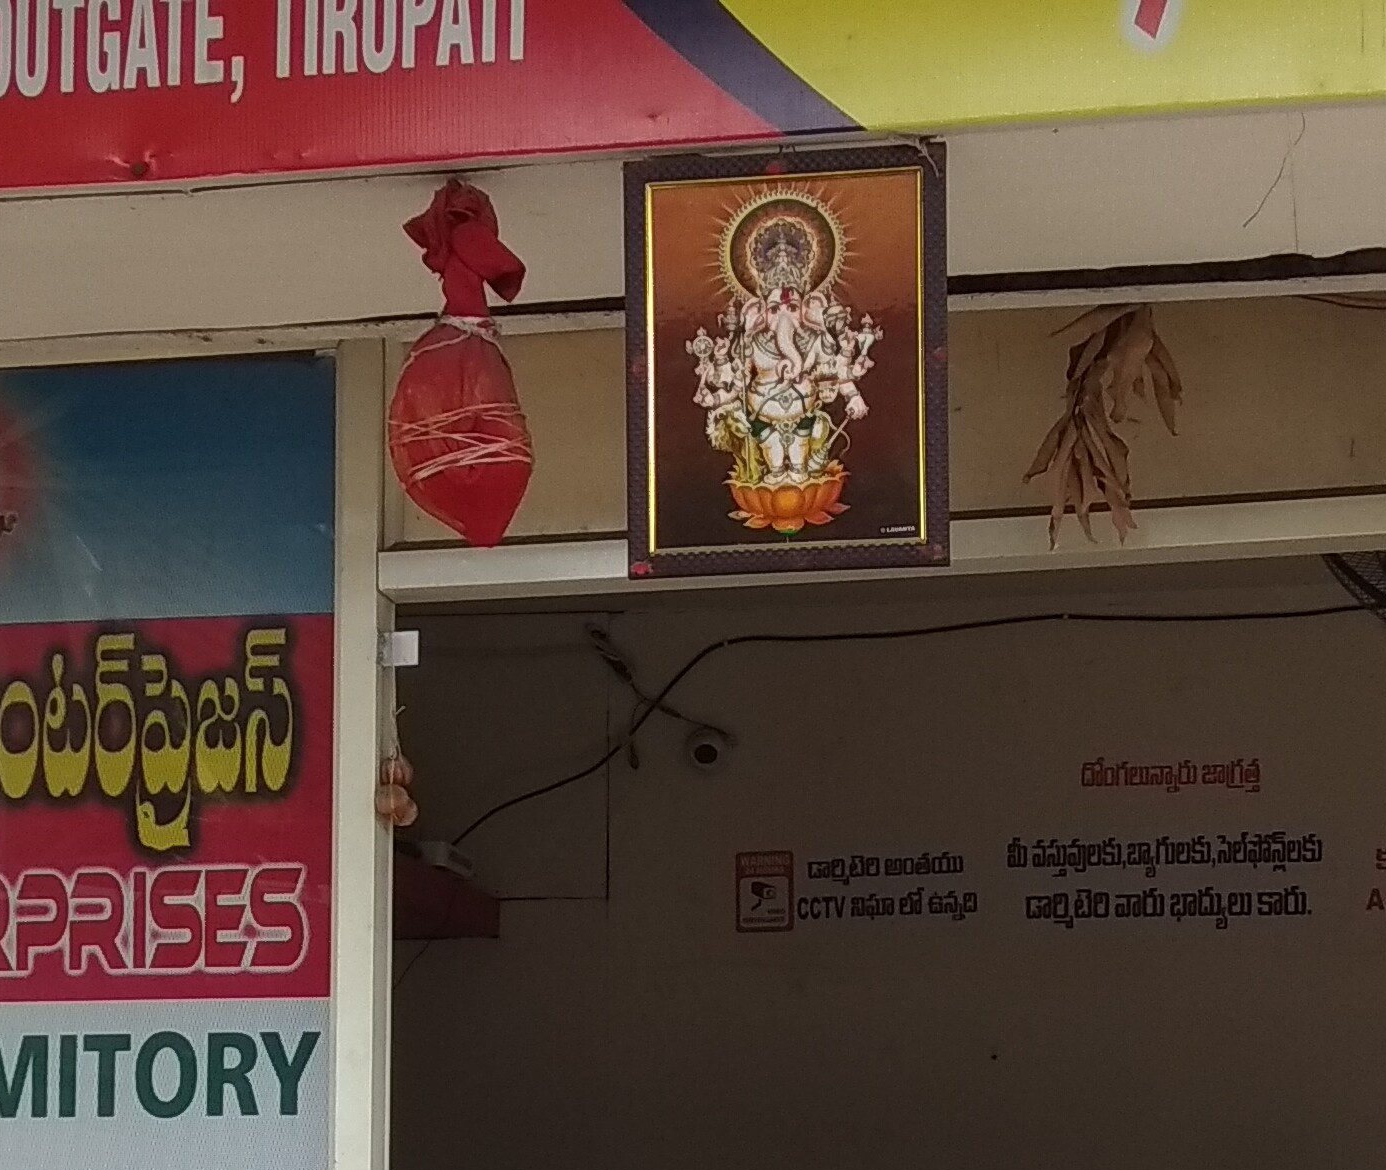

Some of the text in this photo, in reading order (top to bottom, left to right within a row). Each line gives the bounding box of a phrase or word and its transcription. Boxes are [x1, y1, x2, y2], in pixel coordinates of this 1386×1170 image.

[274, 0, 528, 80] TIRUPATI
[797, 896, 846, 920] CCTV
[1114, 887, 1165, 919] వారు
